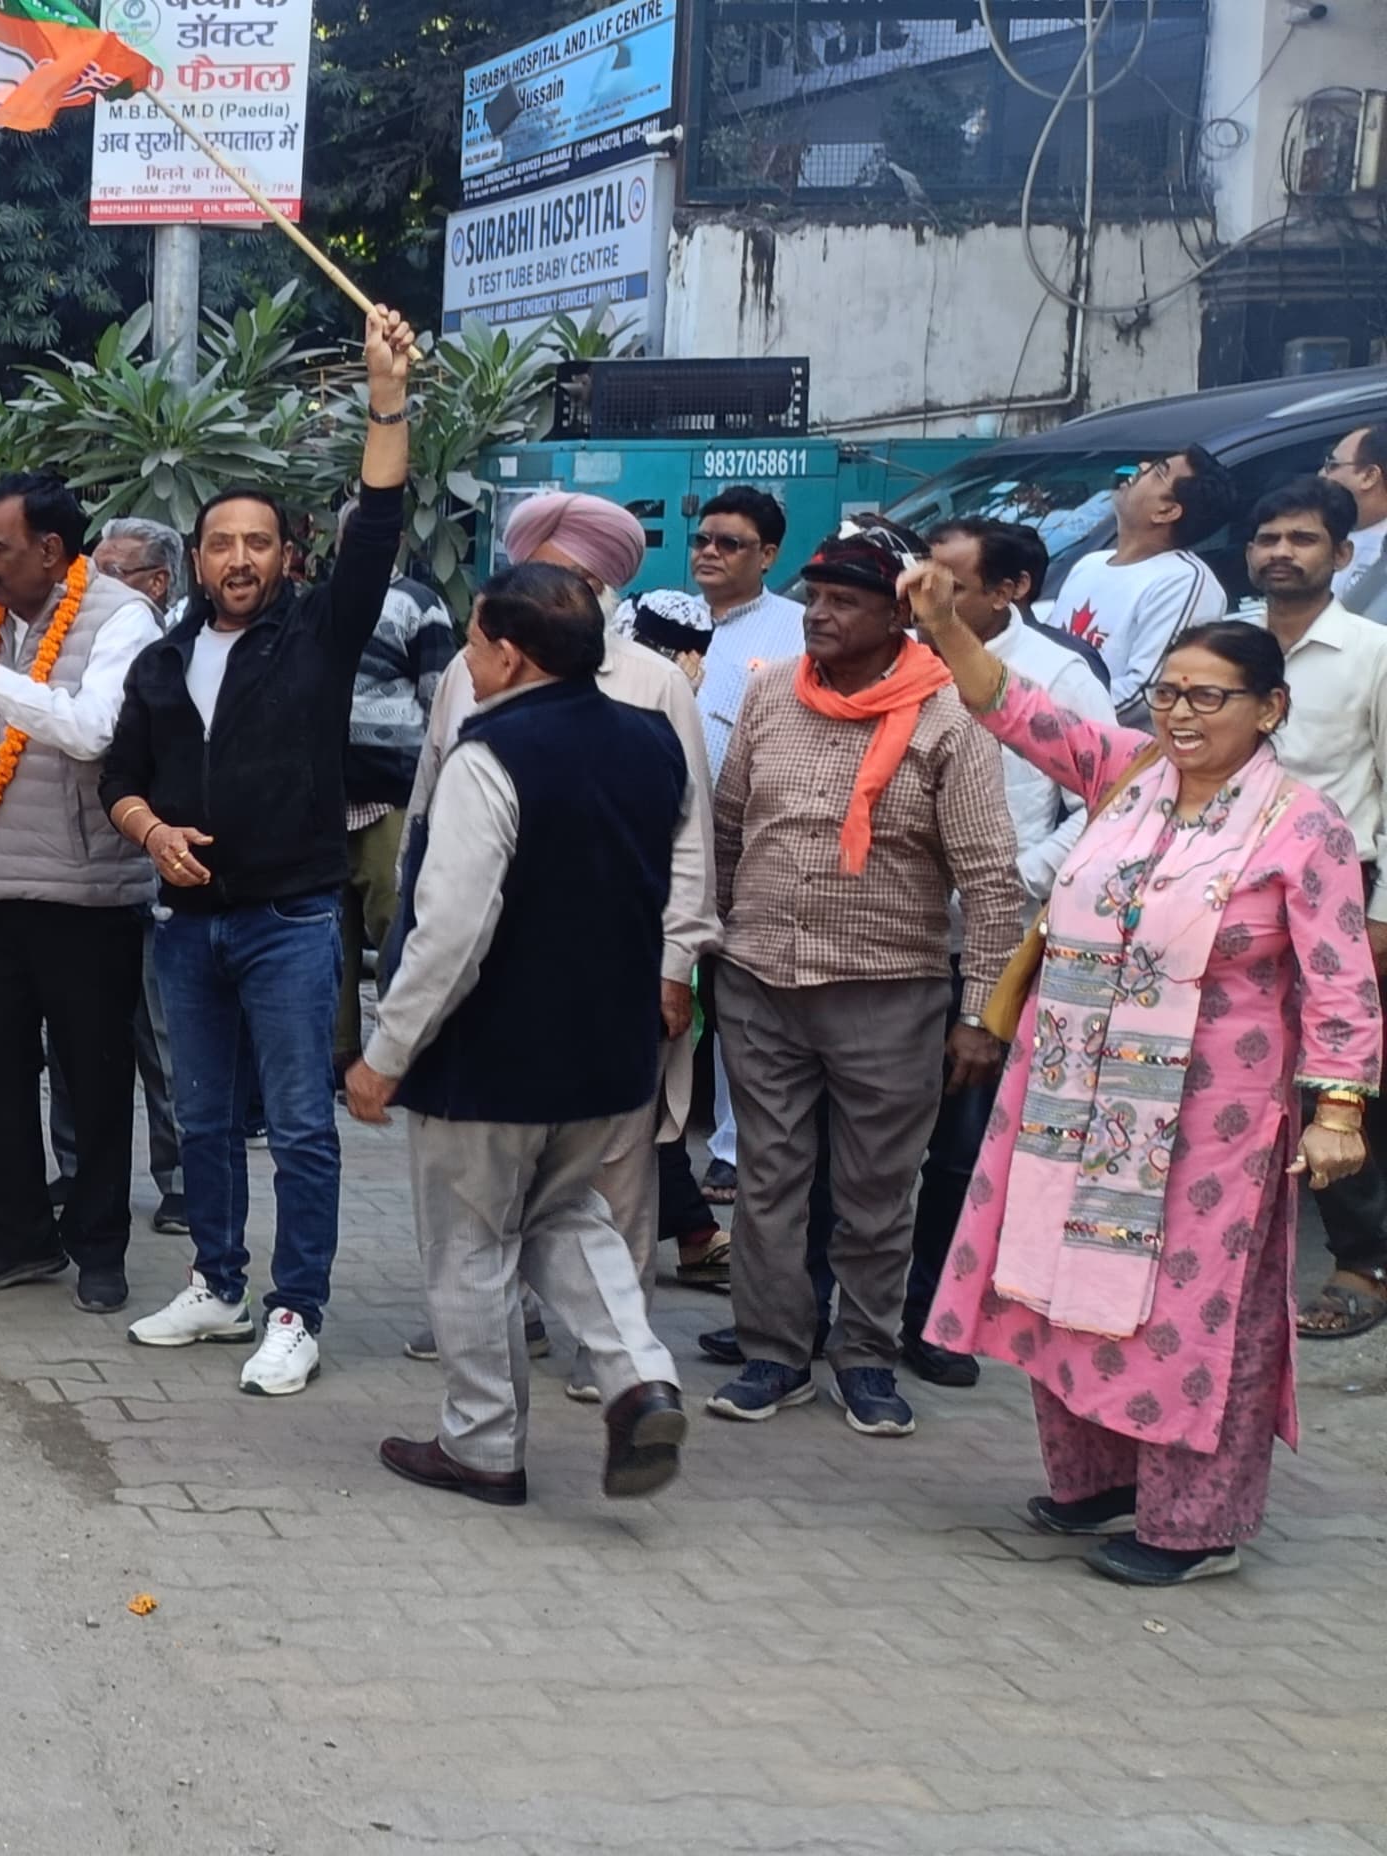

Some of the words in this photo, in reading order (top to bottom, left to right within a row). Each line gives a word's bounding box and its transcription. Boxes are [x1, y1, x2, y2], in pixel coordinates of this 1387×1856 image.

[177, 14, 278, 48] डॉक्टर
[469, 66, 511, 97] SURABHI
[512, 45, 561, 79] HOSPITAL
[563, 30, 586, 58] AND
[589, 18, 612, 46] I.V.F
[615, 1, 662, 34] CENTRE
[177, 54, 295, 92] फैजल
[220, 102, 290, 121] (Paedia)
[467, 109, 479, 132] Dr.
[517, 74, 564, 110] Hussain
[98, 132, 130, 153] अब
[278, 122, 299, 152] में
[466, 206, 535, 266] SURABHI
[538, 180, 625, 249] HOSPITAL
[468, 276, 475, 297] &
[477, 272, 502, 296] TEST
[504, 264, 533, 290] TUBE
[536, 256, 568, 285] BABY
[570, 244, 619, 276] CENTRE
[703, 448, 807, 477] 9837058611
